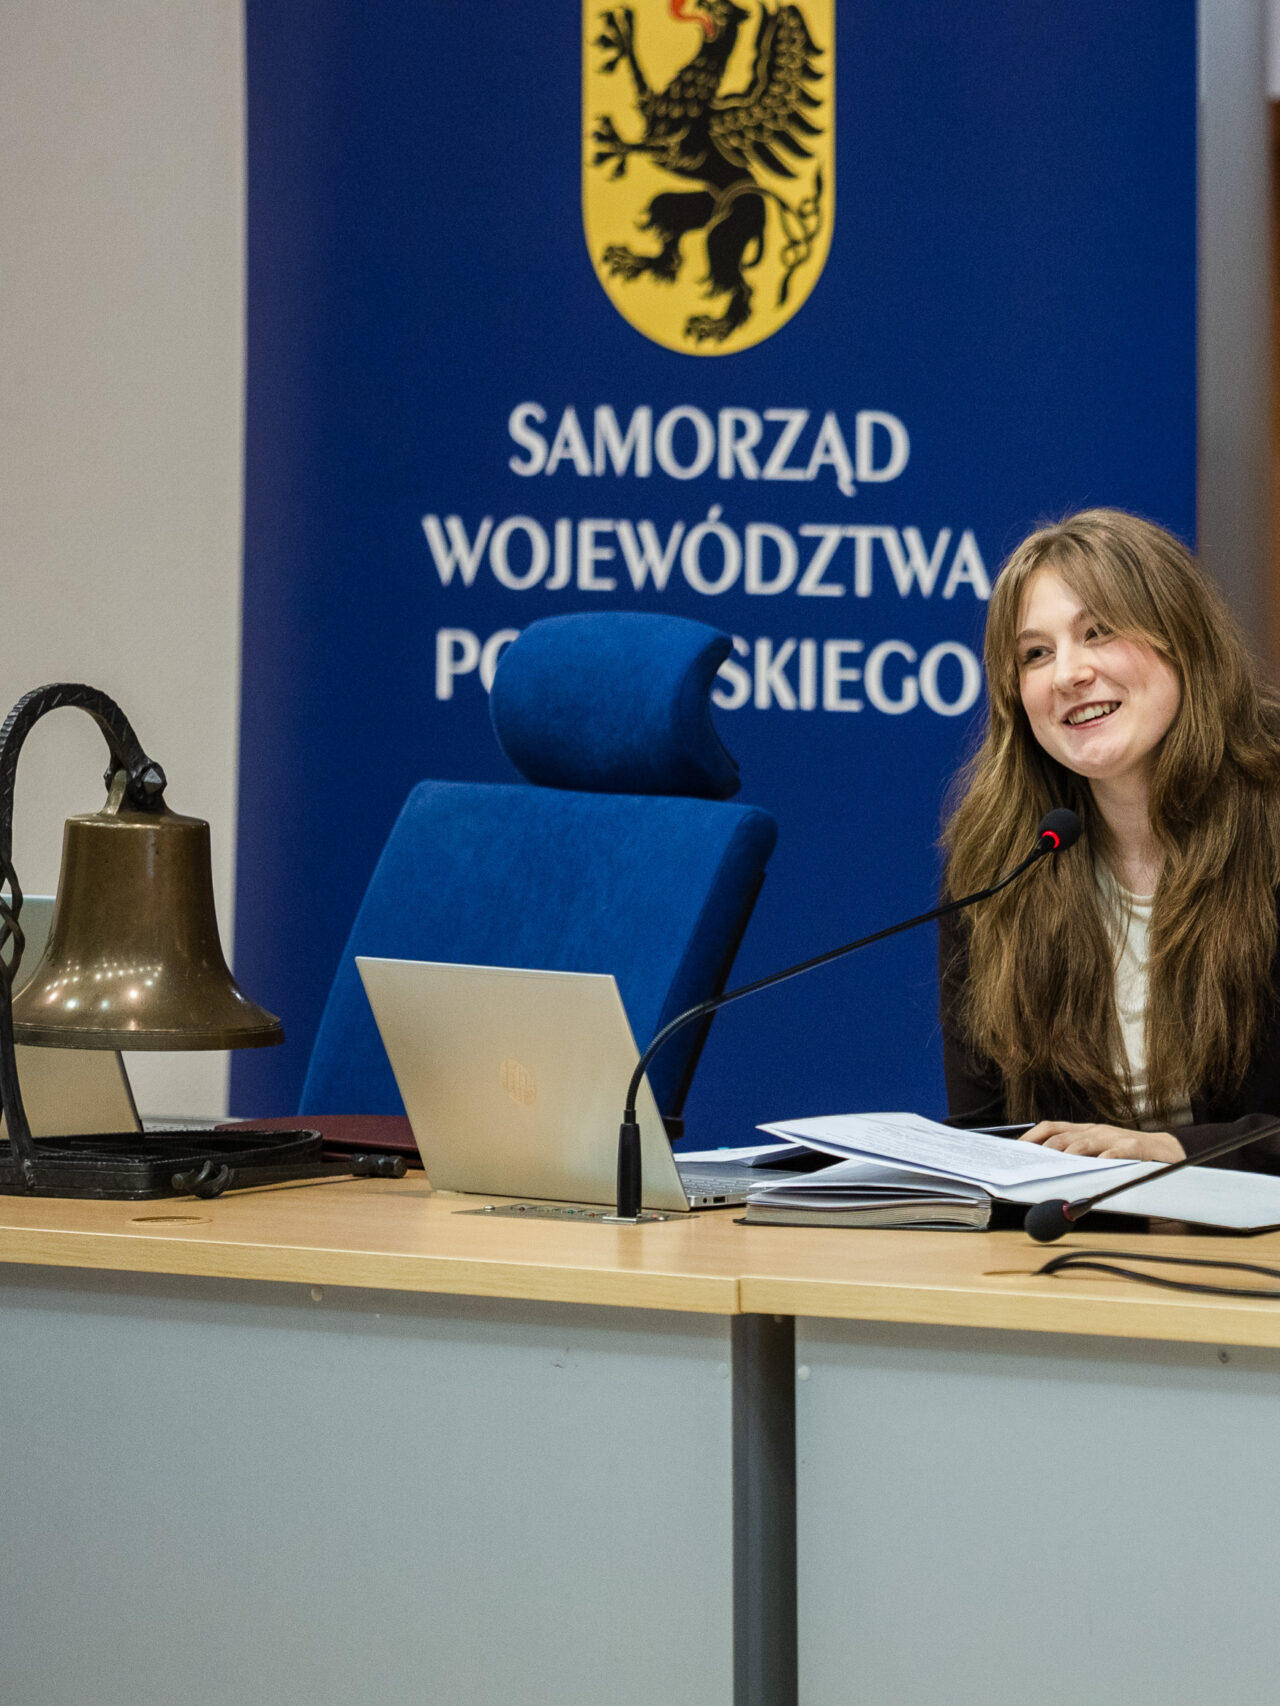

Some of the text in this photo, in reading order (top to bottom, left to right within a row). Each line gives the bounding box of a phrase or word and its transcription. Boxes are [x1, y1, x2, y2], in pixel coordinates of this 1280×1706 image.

[508, 402, 910, 497] SAMORZĄD
[421, 503, 993, 600] WOJEWÓDZTWA
[434, 628, 983, 717] PSKIEGO
